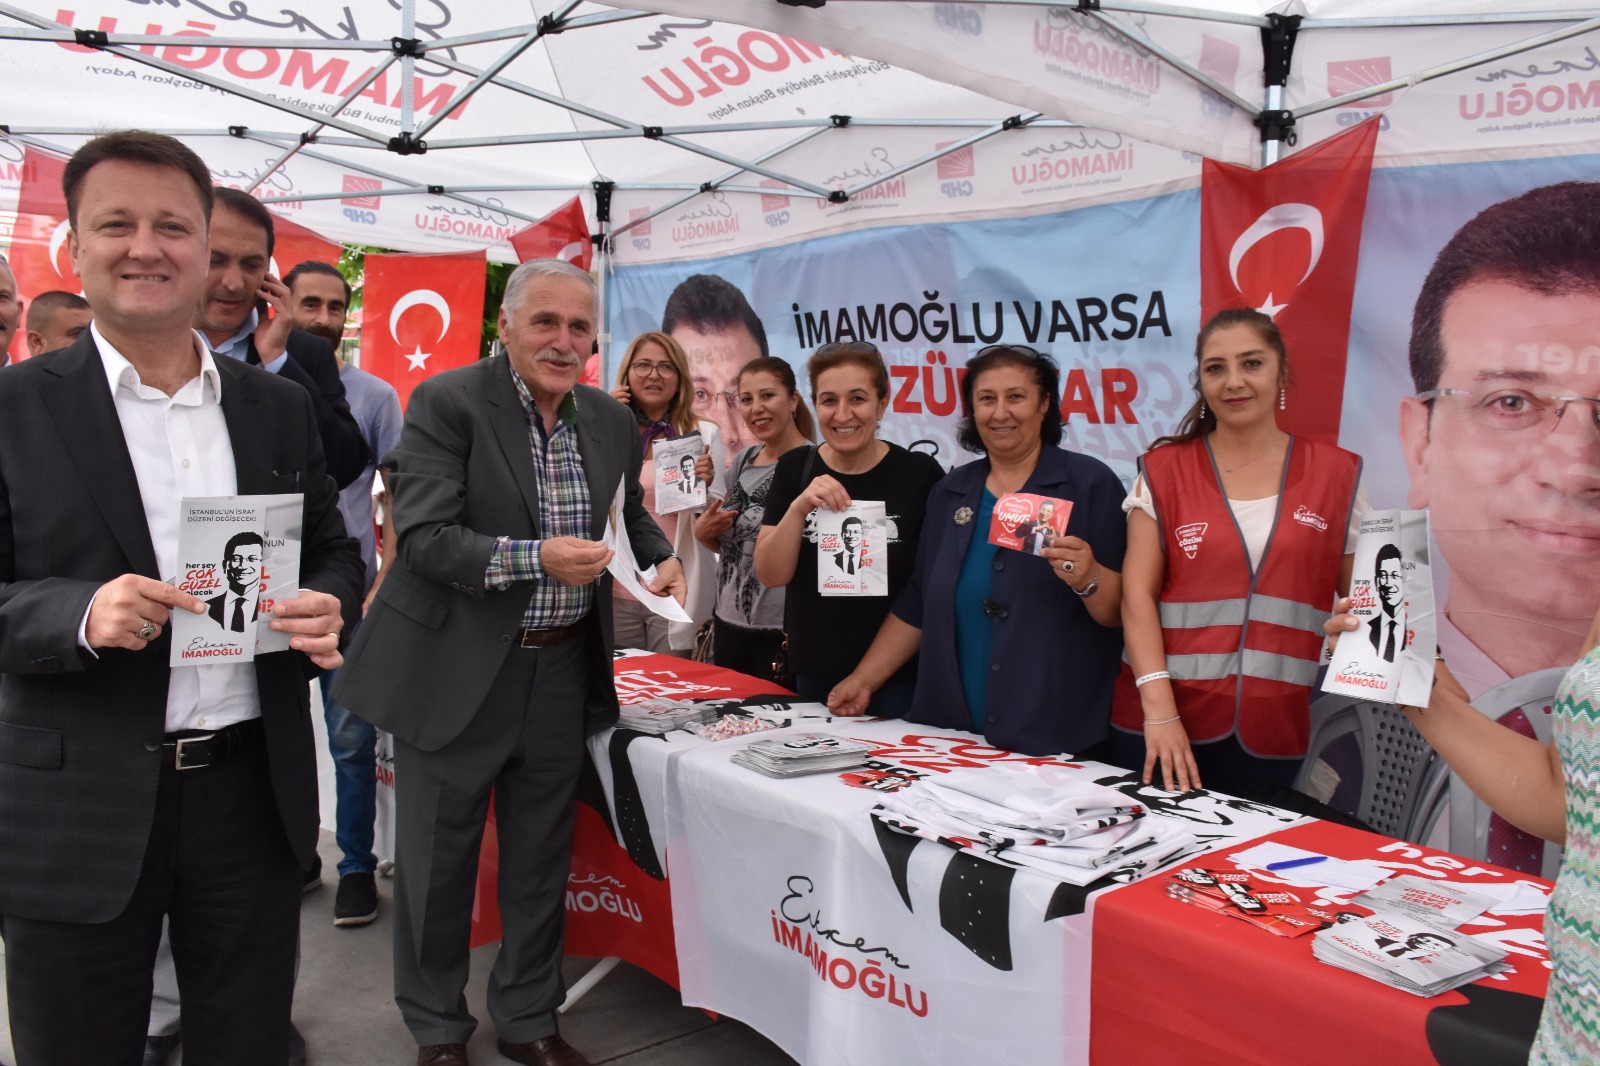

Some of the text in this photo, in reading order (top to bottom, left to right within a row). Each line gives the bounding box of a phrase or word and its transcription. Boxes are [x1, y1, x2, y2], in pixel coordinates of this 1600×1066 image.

[792, 290, 1172, 349] İMAMOĞLU VARSA
[1057, 367, 1139, 425] AR
[187, 515, 257, 523] DÜZENİ DEĞİŞECEK!
[998, 511, 1031, 524] UMUT
[1178, 536, 1203, 547] ÇÖZÜM
[1183, 544, 1198, 552] VAR
[201, 562, 217, 570] şey
[186, 568, 217, 581] ÇOK
[178, 577, 222, 591] GÜZEL
[1353, 586, 1370, 598] ÇOK
[1349, 596, 1377, 609] GÜZEL
[1352, 608, 1373, 616] olacak
[188, 636, 238, 651] Ekrem
[181, 648, 243, 659] İMAMOĞLU
[1334, 673, 1388, 690] İMAMOĞLU
[1377, 841, 1504, 877] her
[564, 886, 643, 923] MOĞLU
[780, 875, 911, 970] Ekrem
[770, 909, 928, 1018] İMAMOĞLU
